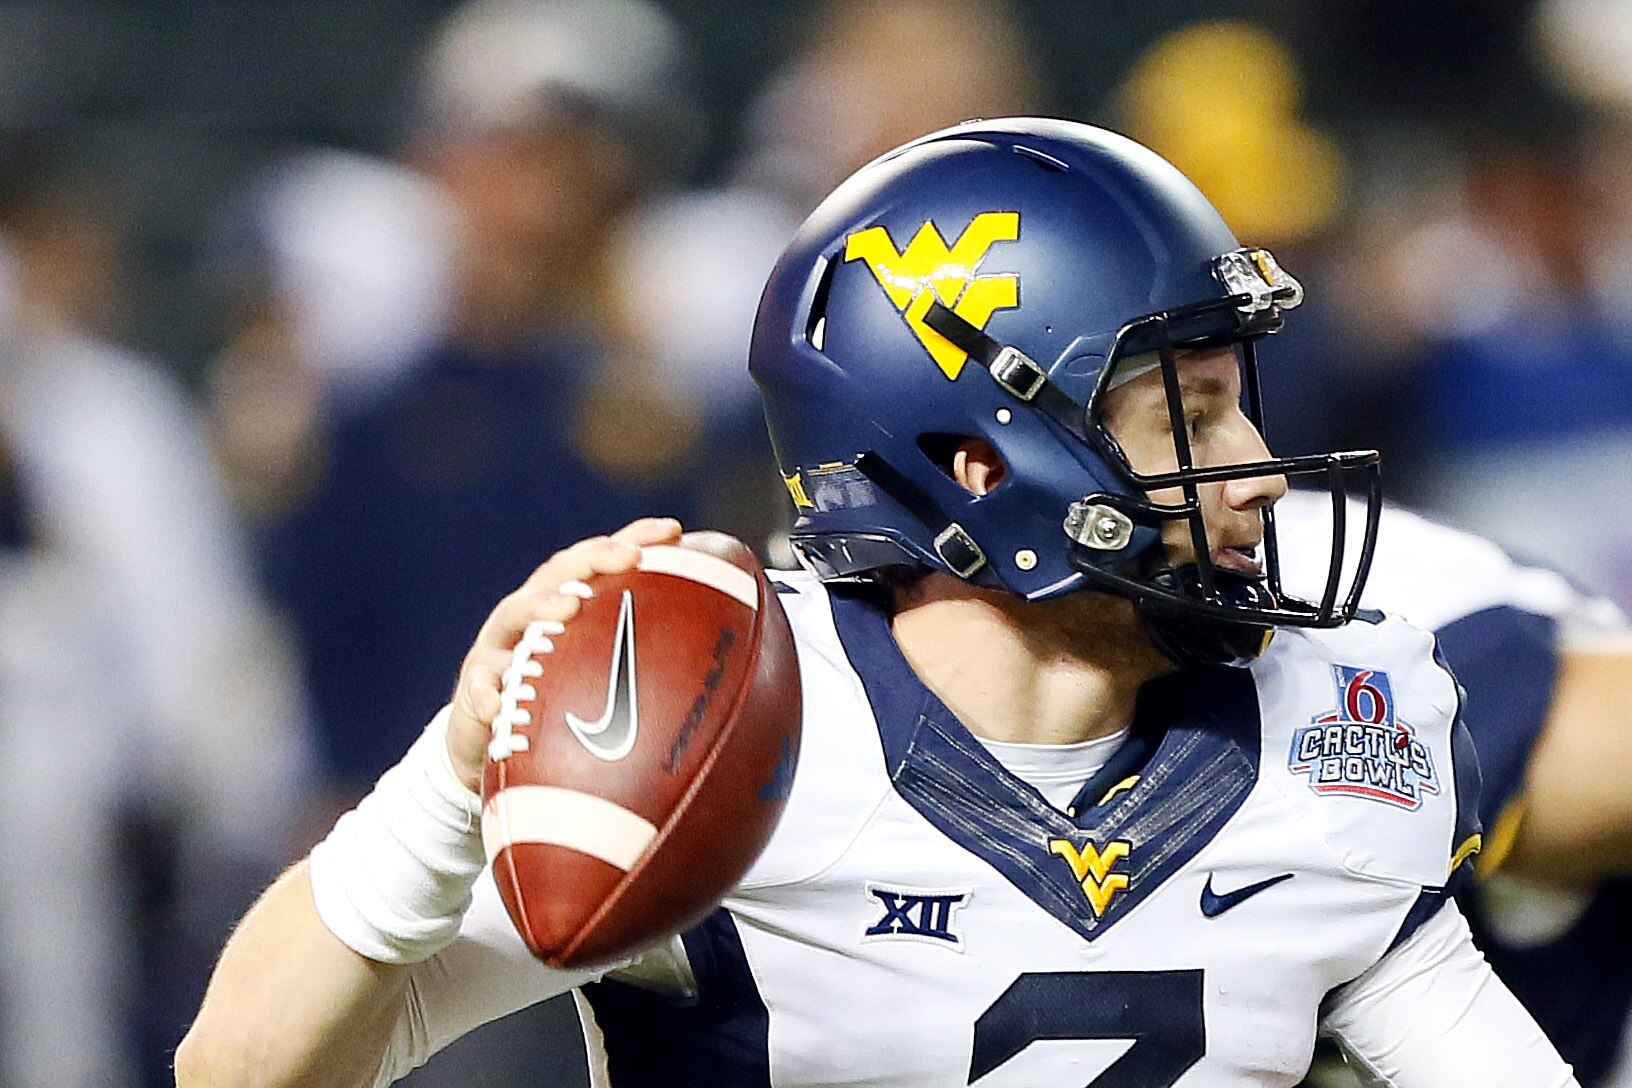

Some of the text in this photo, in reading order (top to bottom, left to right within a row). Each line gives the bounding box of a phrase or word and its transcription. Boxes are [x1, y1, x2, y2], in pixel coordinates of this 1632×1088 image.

[1346, 669, 1387, 724] 6
[1298, 724, 1432, 780] CACTUS
[1318, 756, 1415, 798] BOWL
[865, 889, 965, 943] XII
